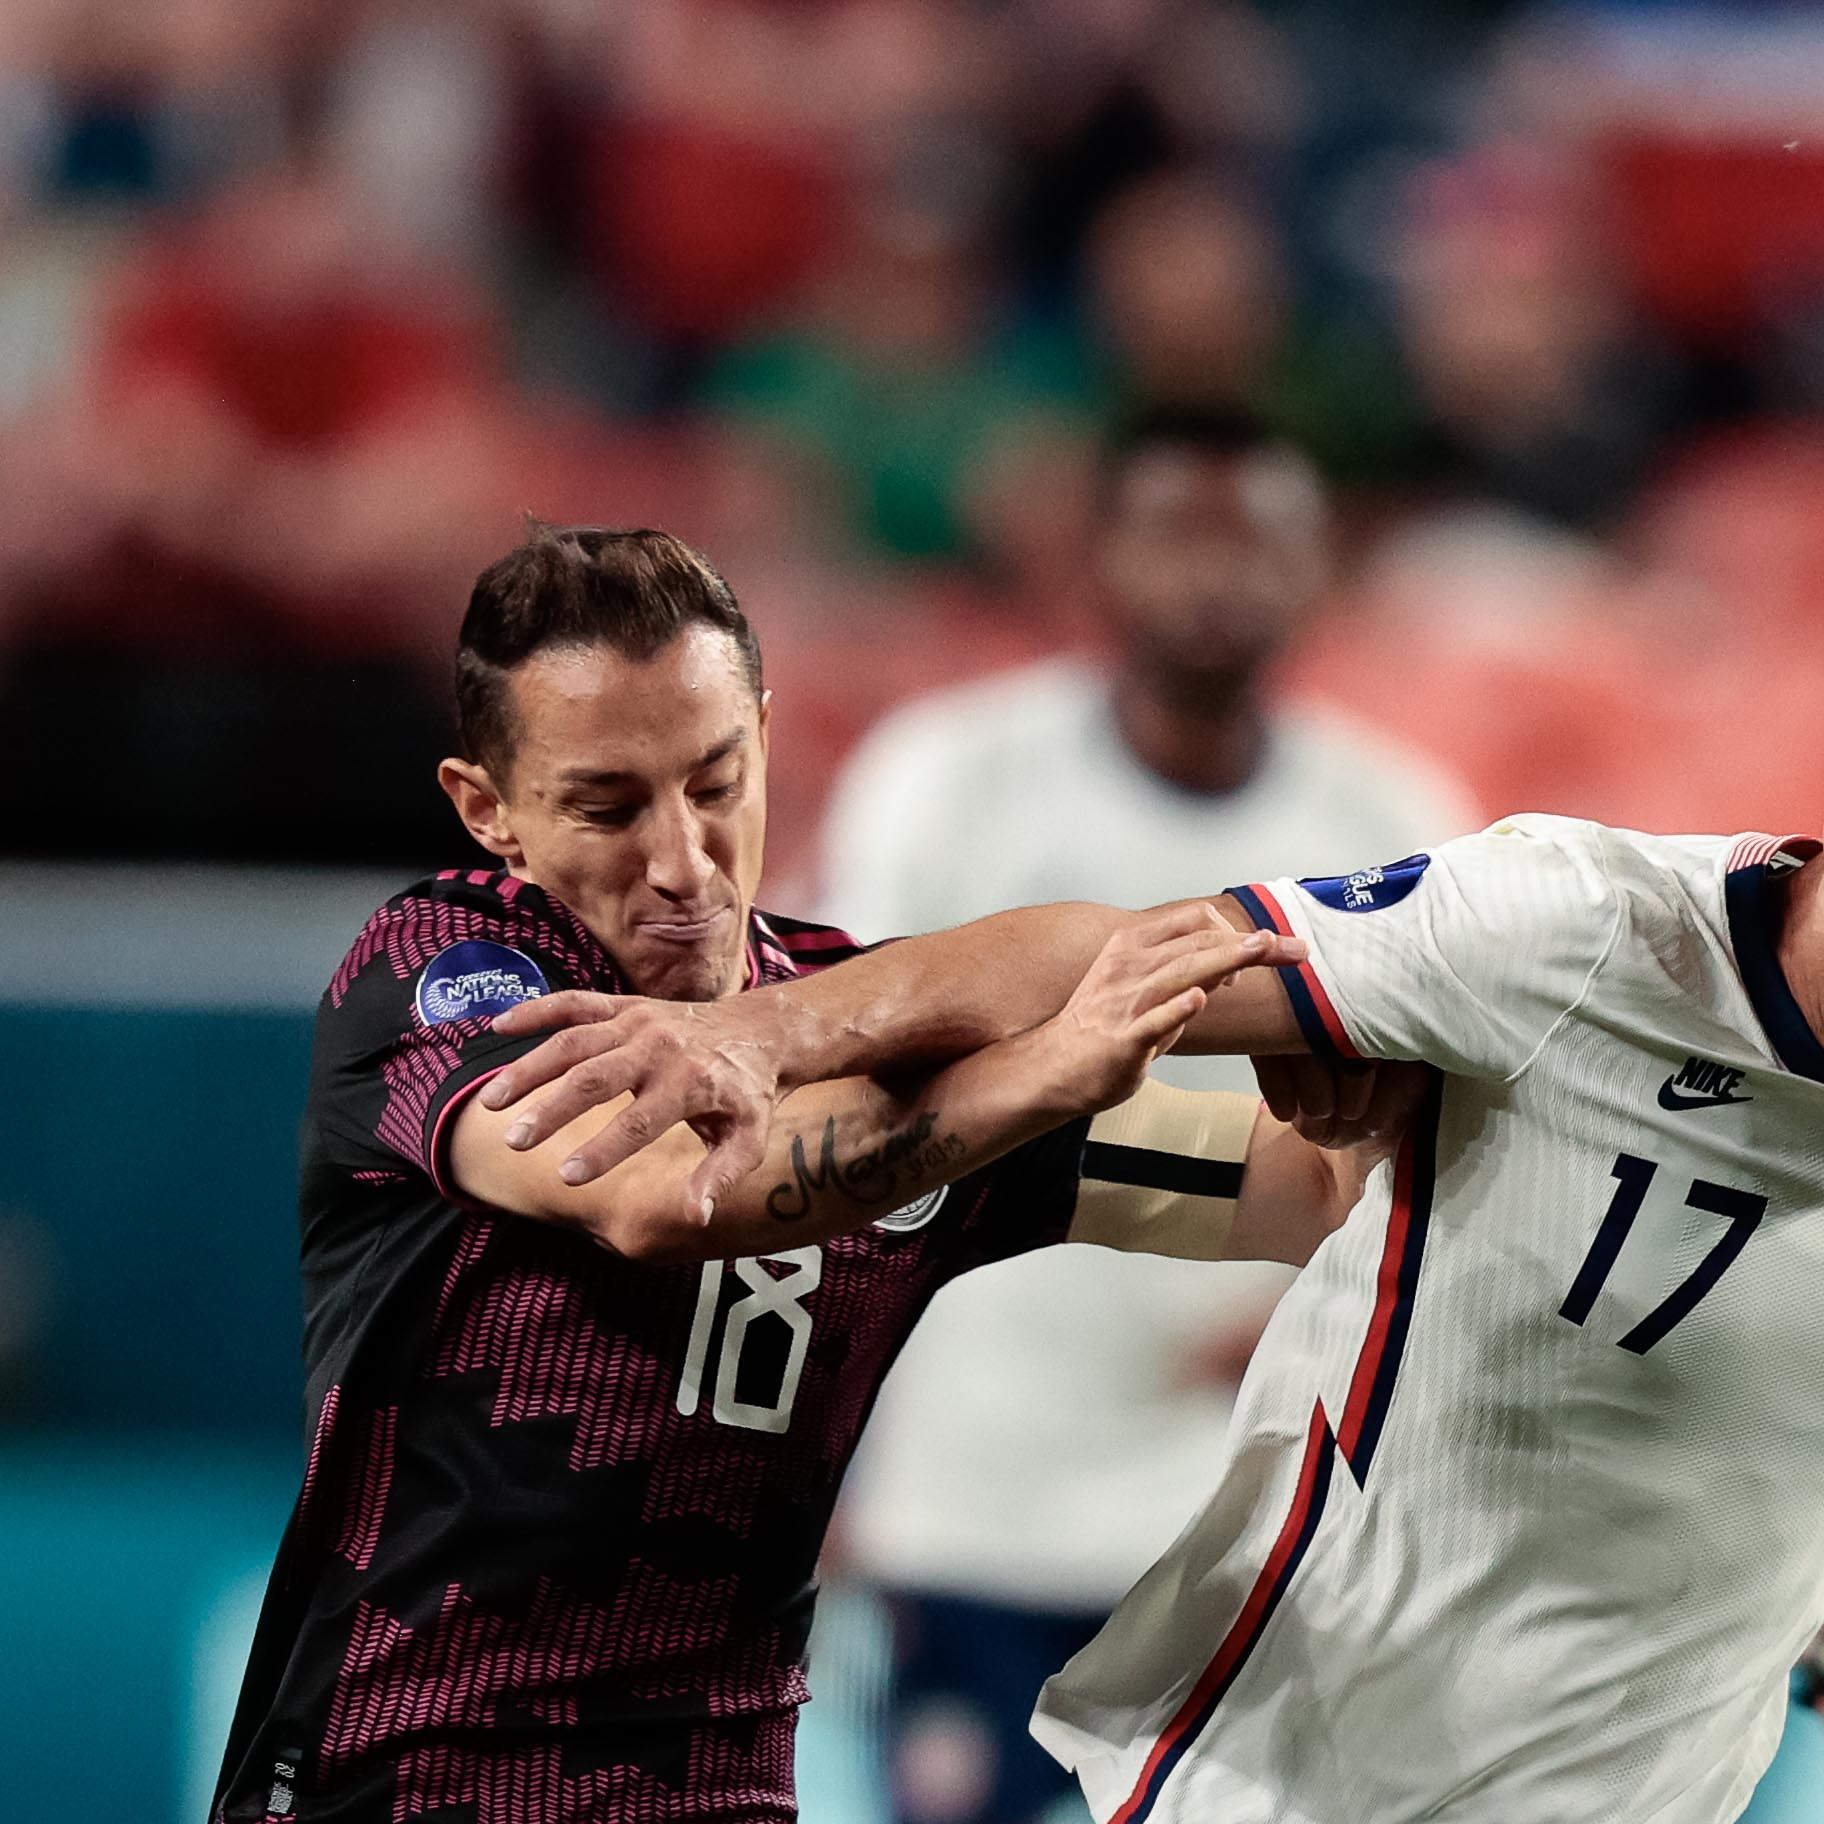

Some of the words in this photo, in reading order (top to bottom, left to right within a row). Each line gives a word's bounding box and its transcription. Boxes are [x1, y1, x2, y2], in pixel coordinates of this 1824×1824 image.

[447, 975, 521, 1001] NATIONS
[474, 985, 542, 1003] LEAGUE
[1673, 1057, 1746, 1099] NIKE
[1559, 1153, 1768, 1355] 17
[677, 1245, 822, 1434] 18
